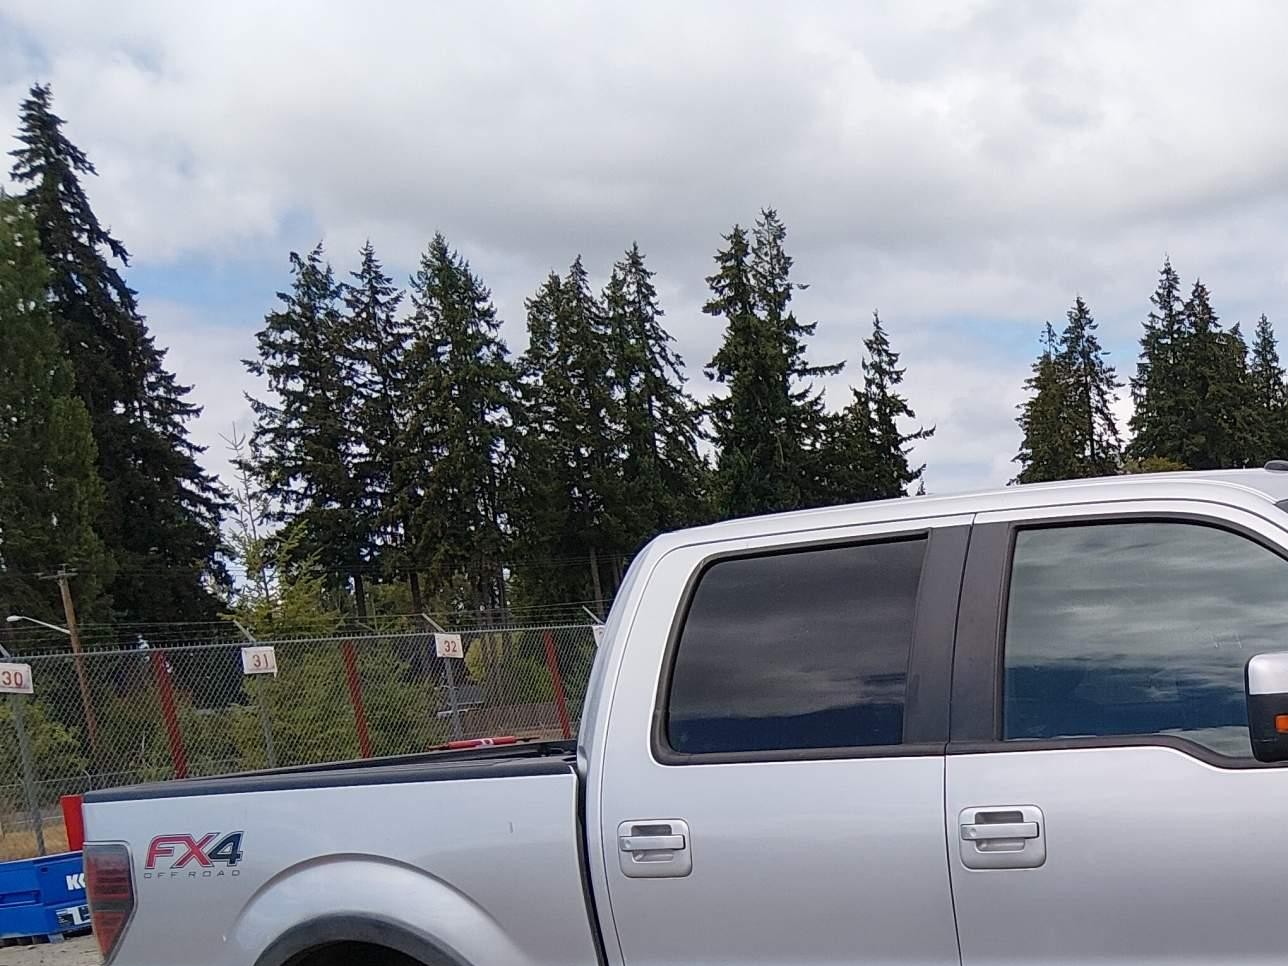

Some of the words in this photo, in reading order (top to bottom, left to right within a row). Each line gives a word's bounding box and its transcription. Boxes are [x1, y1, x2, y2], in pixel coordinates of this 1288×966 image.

[443, 640, 457, 653] 32
[252, 653, 269, 669] 31
[1, 670, 24, 687] 30
[144, 830, 244, 870] FX4
